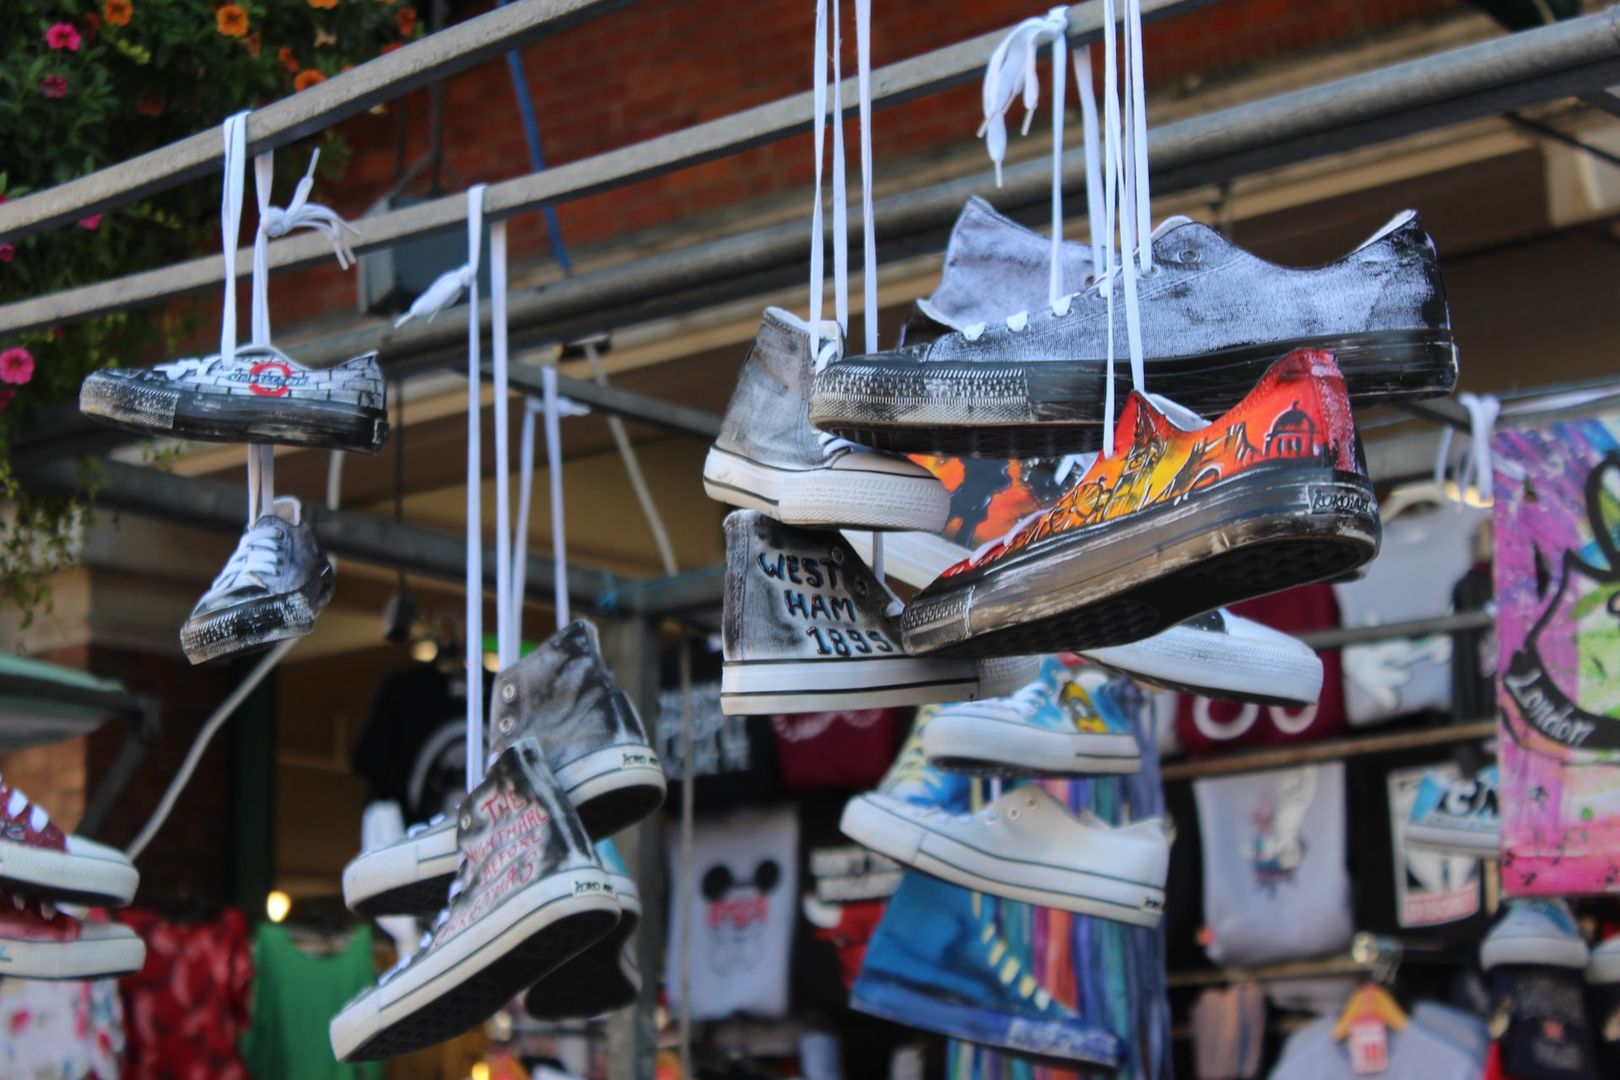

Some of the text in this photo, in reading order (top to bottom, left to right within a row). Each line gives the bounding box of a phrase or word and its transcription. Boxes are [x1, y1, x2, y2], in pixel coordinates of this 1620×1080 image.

[758, 552, 841, 589] WEST
[784, 590, 856, 623] HAM
[1504, 668, 1595, 746] London
[481, 790, 526, 827] THE
[482, 834, 542, 884] BEFORE
